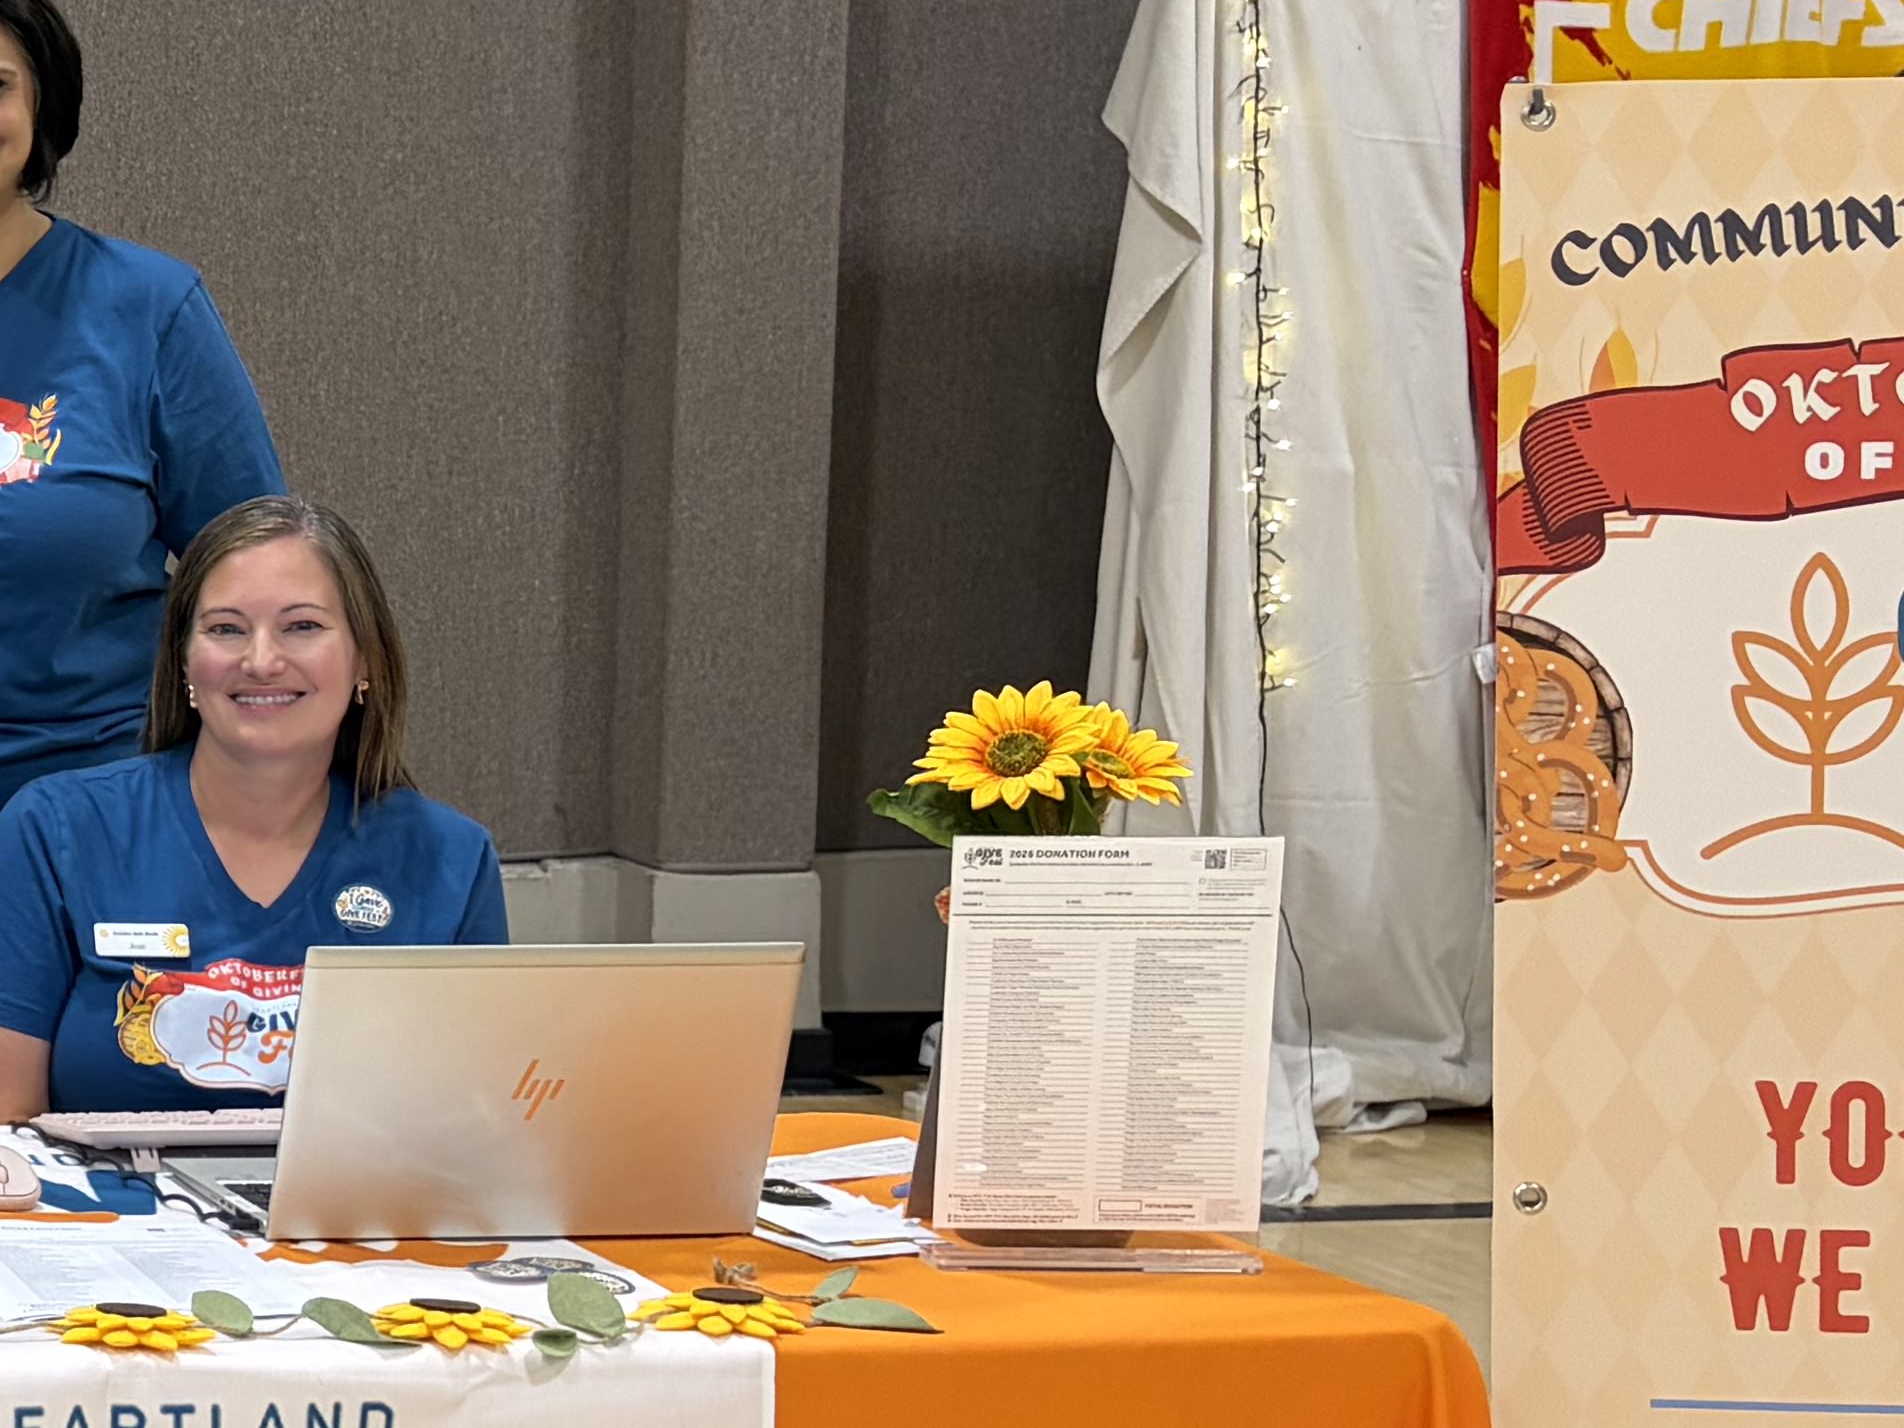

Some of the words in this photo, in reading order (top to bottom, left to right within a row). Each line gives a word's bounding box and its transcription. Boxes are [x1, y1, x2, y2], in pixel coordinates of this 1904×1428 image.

[1551, 194, 1904, 286] COMMUN
[1804, 440, 1895, 481] OF
[1036, 849, 1095, 860] DONATION
[1096, 849, 1130, 860] FORM
[207, 961, 304, 983] OKTOBERF
[246, 1010, 299, 1033] GIV
[511, 1058, 566, 1121] hp
[1754, 1080, 1904, 1188] YO
[1718, 1227, 1872, 1334] WE
